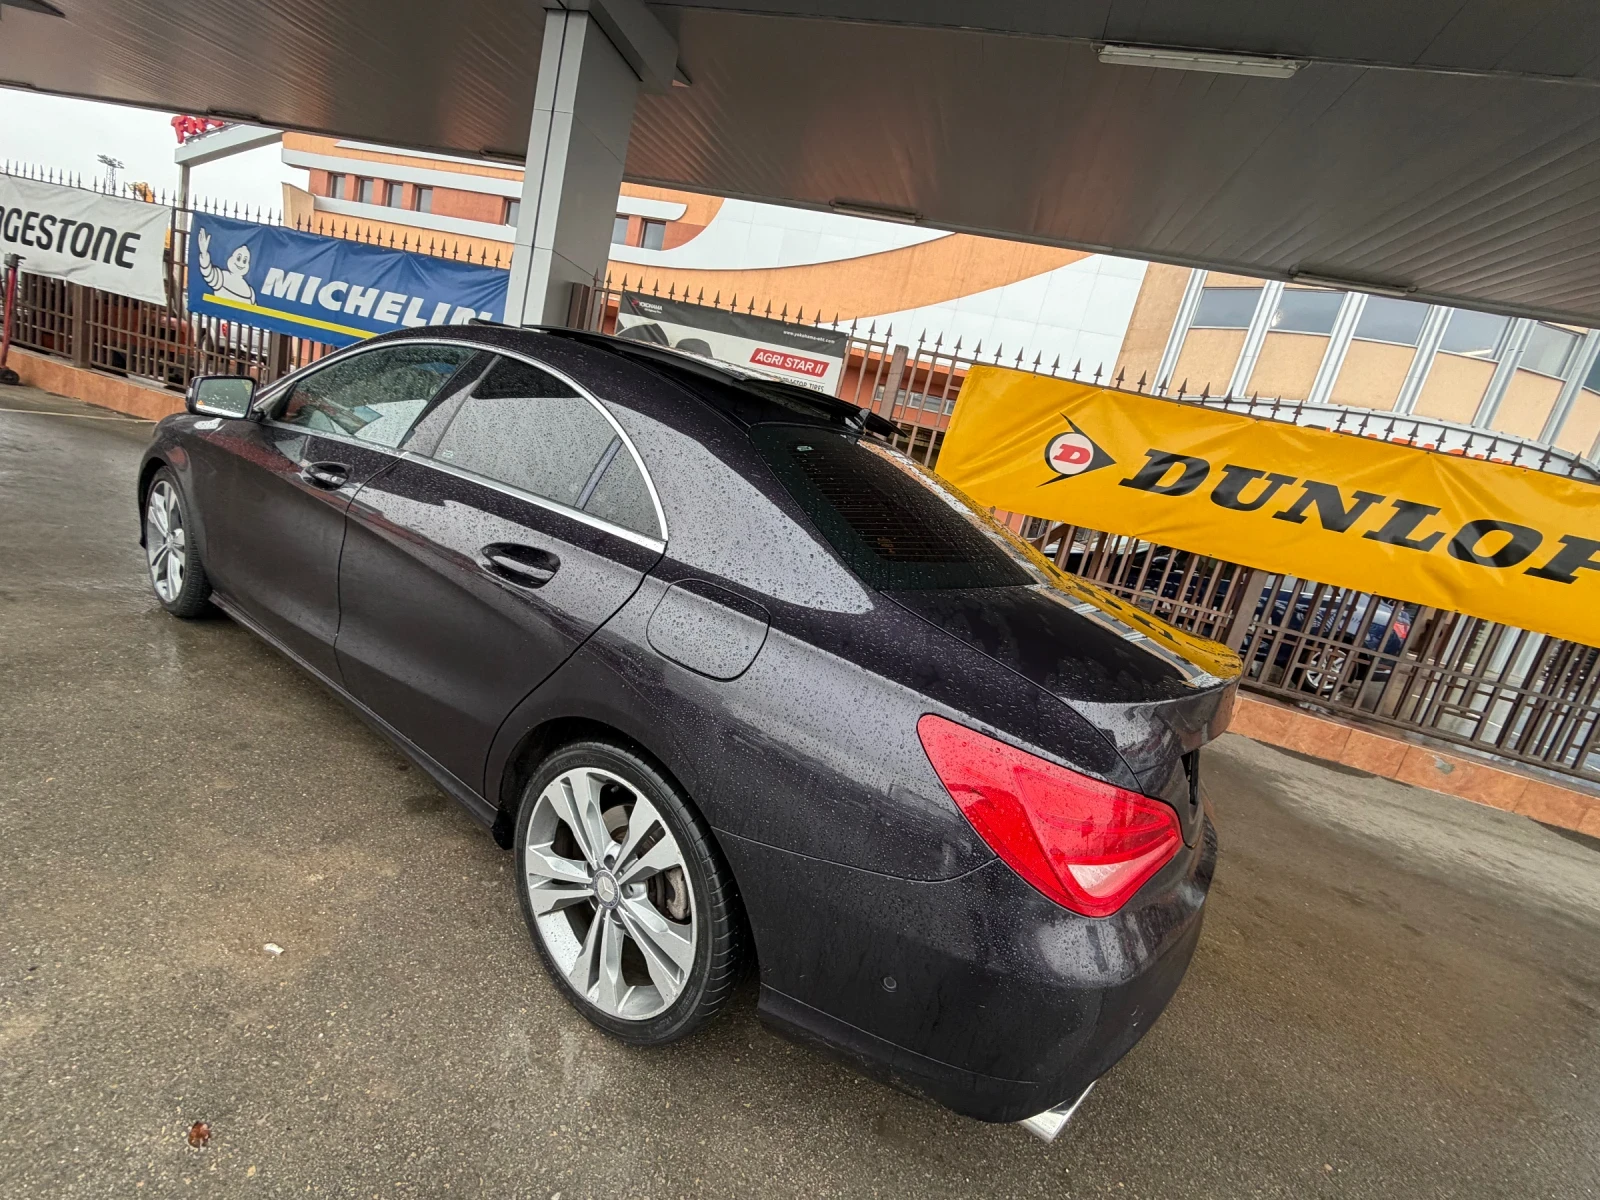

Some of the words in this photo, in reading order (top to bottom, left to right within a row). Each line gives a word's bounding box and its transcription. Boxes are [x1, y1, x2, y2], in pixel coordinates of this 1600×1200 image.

[0, 206, 141, 269] GESTONE
[755, 351, 784, 366] AGRI
[784, 357, 814, 372] STAR
[815, 364, 824, 375] II
[1053, 443, 1091, 465] D
